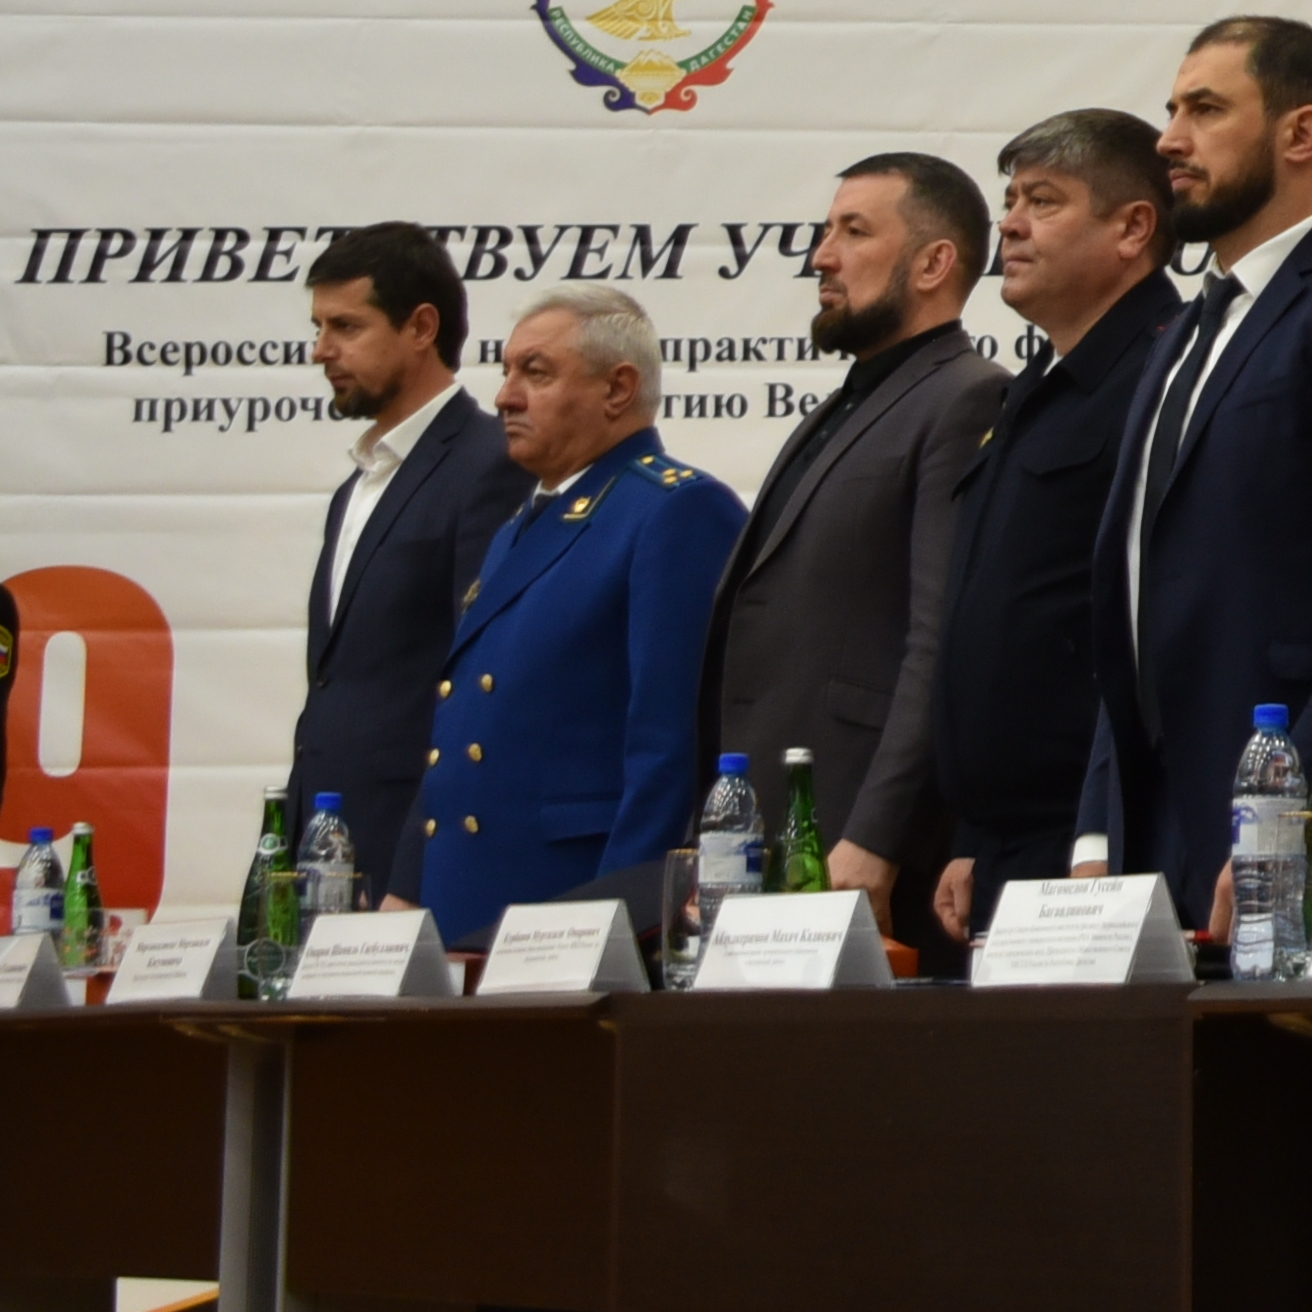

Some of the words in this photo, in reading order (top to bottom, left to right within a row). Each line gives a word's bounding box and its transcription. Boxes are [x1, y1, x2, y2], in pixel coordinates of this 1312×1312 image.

[551, 8, 616, 73] РЕСПУБЛИКА
[688, 8, 754, 73] ДАГЕСТАН
[14, 222, 698, 285] ПРИВЕВУЕМ
[102, 330, 317, 376] Всеросси
